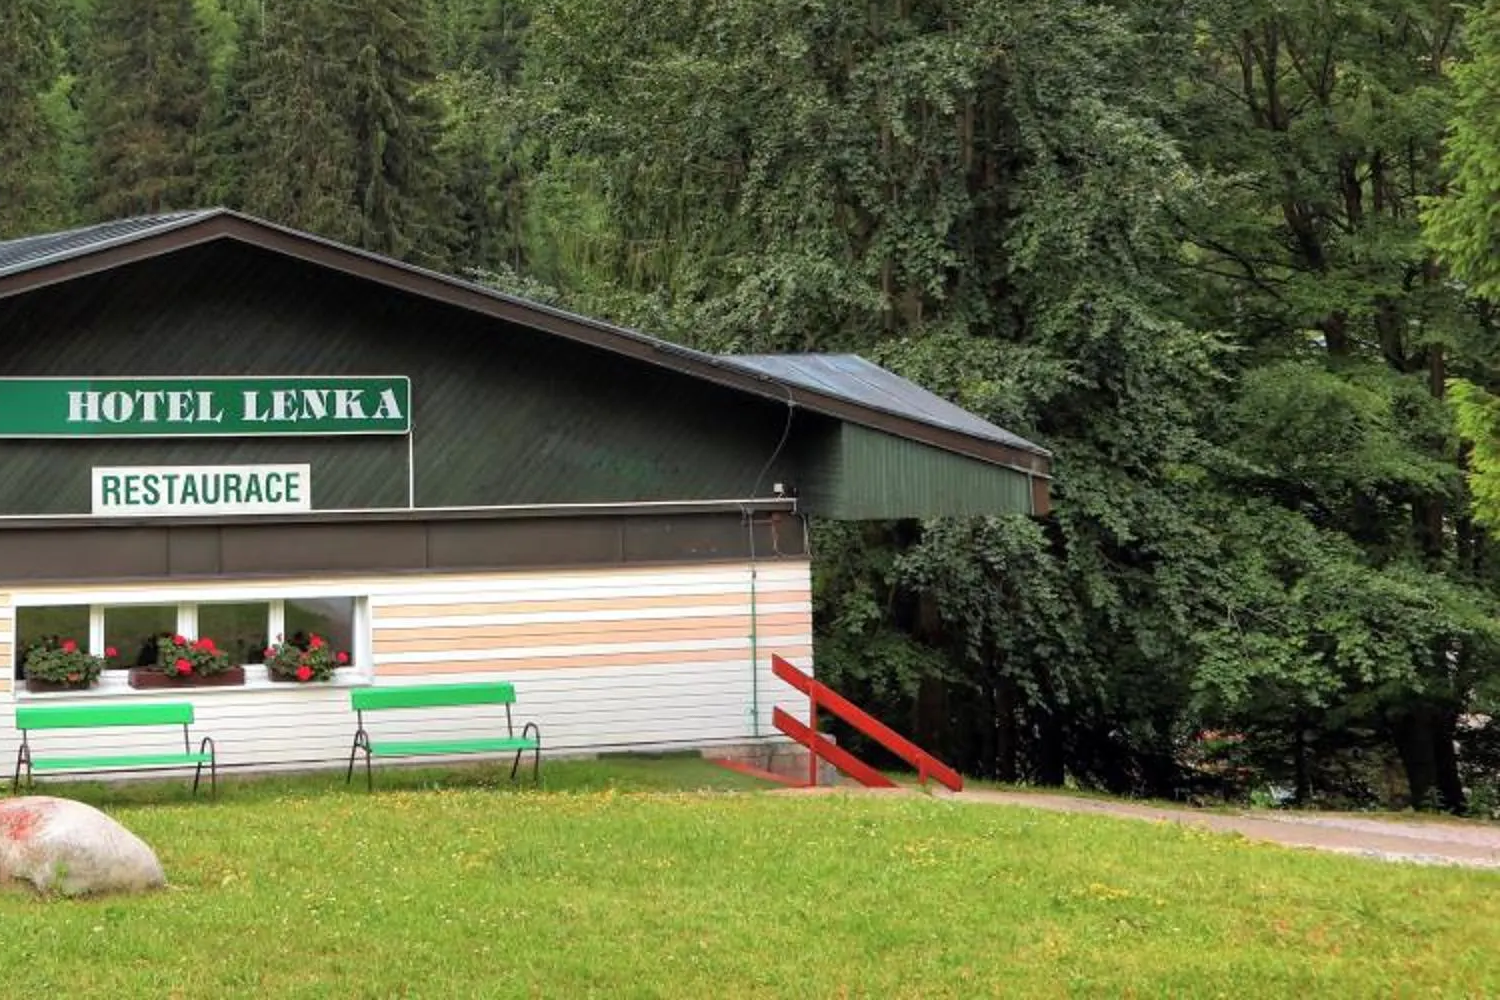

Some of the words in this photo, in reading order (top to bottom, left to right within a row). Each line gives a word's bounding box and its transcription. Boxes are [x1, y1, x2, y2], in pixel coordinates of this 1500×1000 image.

[67, 390, 224, 423] HOTEL
[242, 388, 404, 422] LENKA
[102, 472, 299, 505] RESTAURACE
